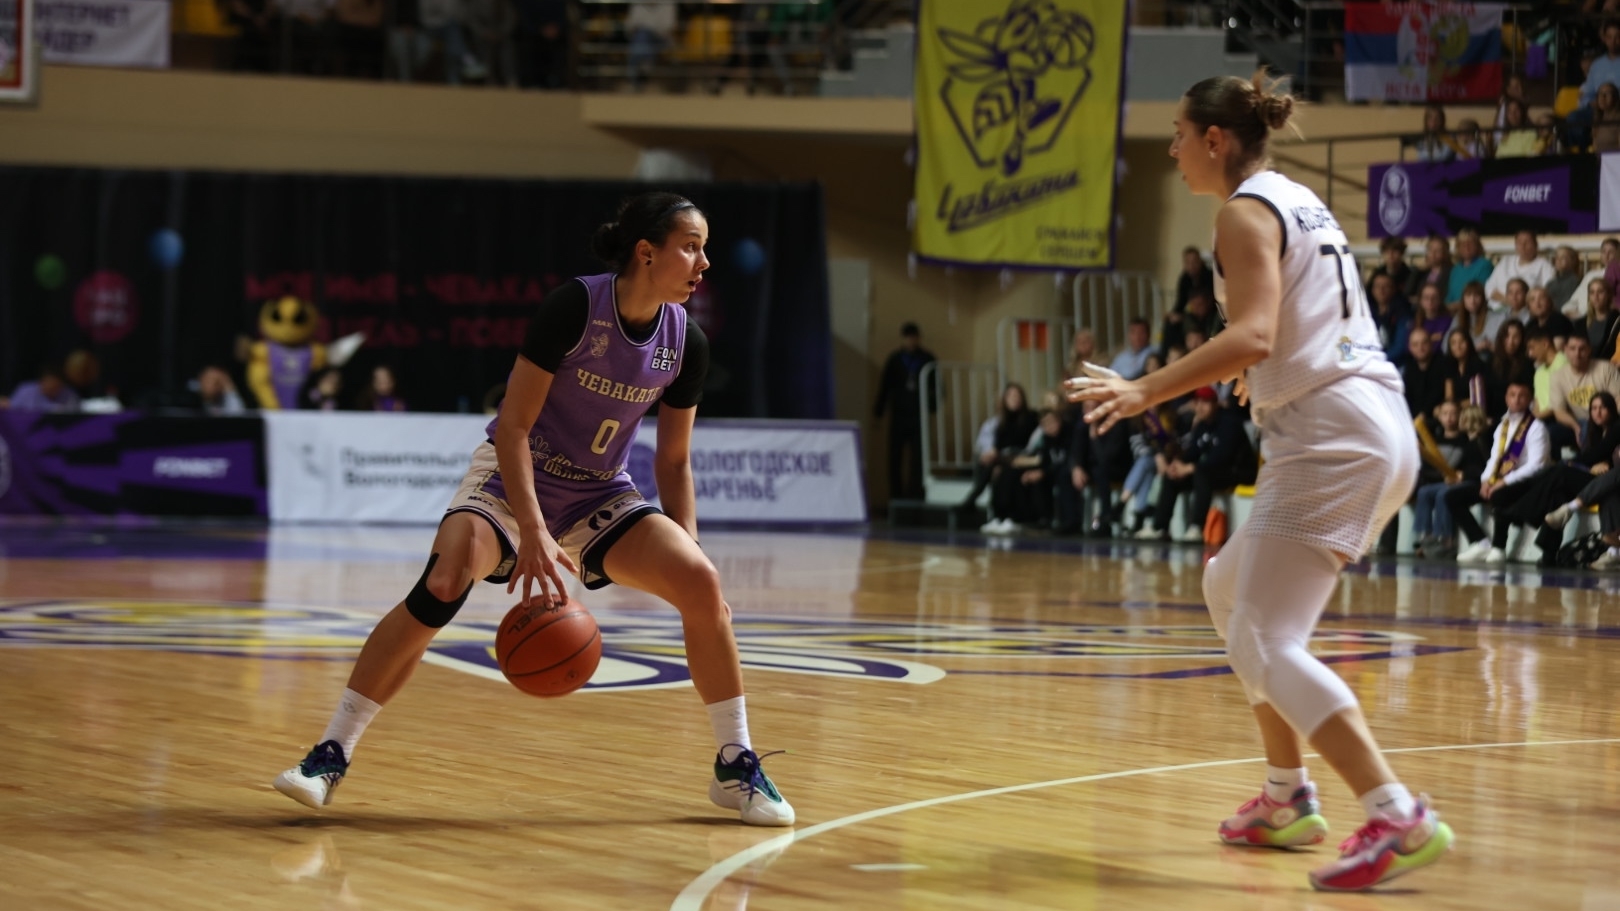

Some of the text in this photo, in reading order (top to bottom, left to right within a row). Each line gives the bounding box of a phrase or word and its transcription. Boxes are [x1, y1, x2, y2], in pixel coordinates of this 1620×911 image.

[1504, 183, 1551, 204] FONBET
[651, 358, 675, 371] BET
[654, 347, 677, 360] FON
[590, 419, 620, 454] 0
[691, 451, 834, 477] ОЛОГОДСКОЕ
[695, 476, 777, 502] АРЕНЬЕ
